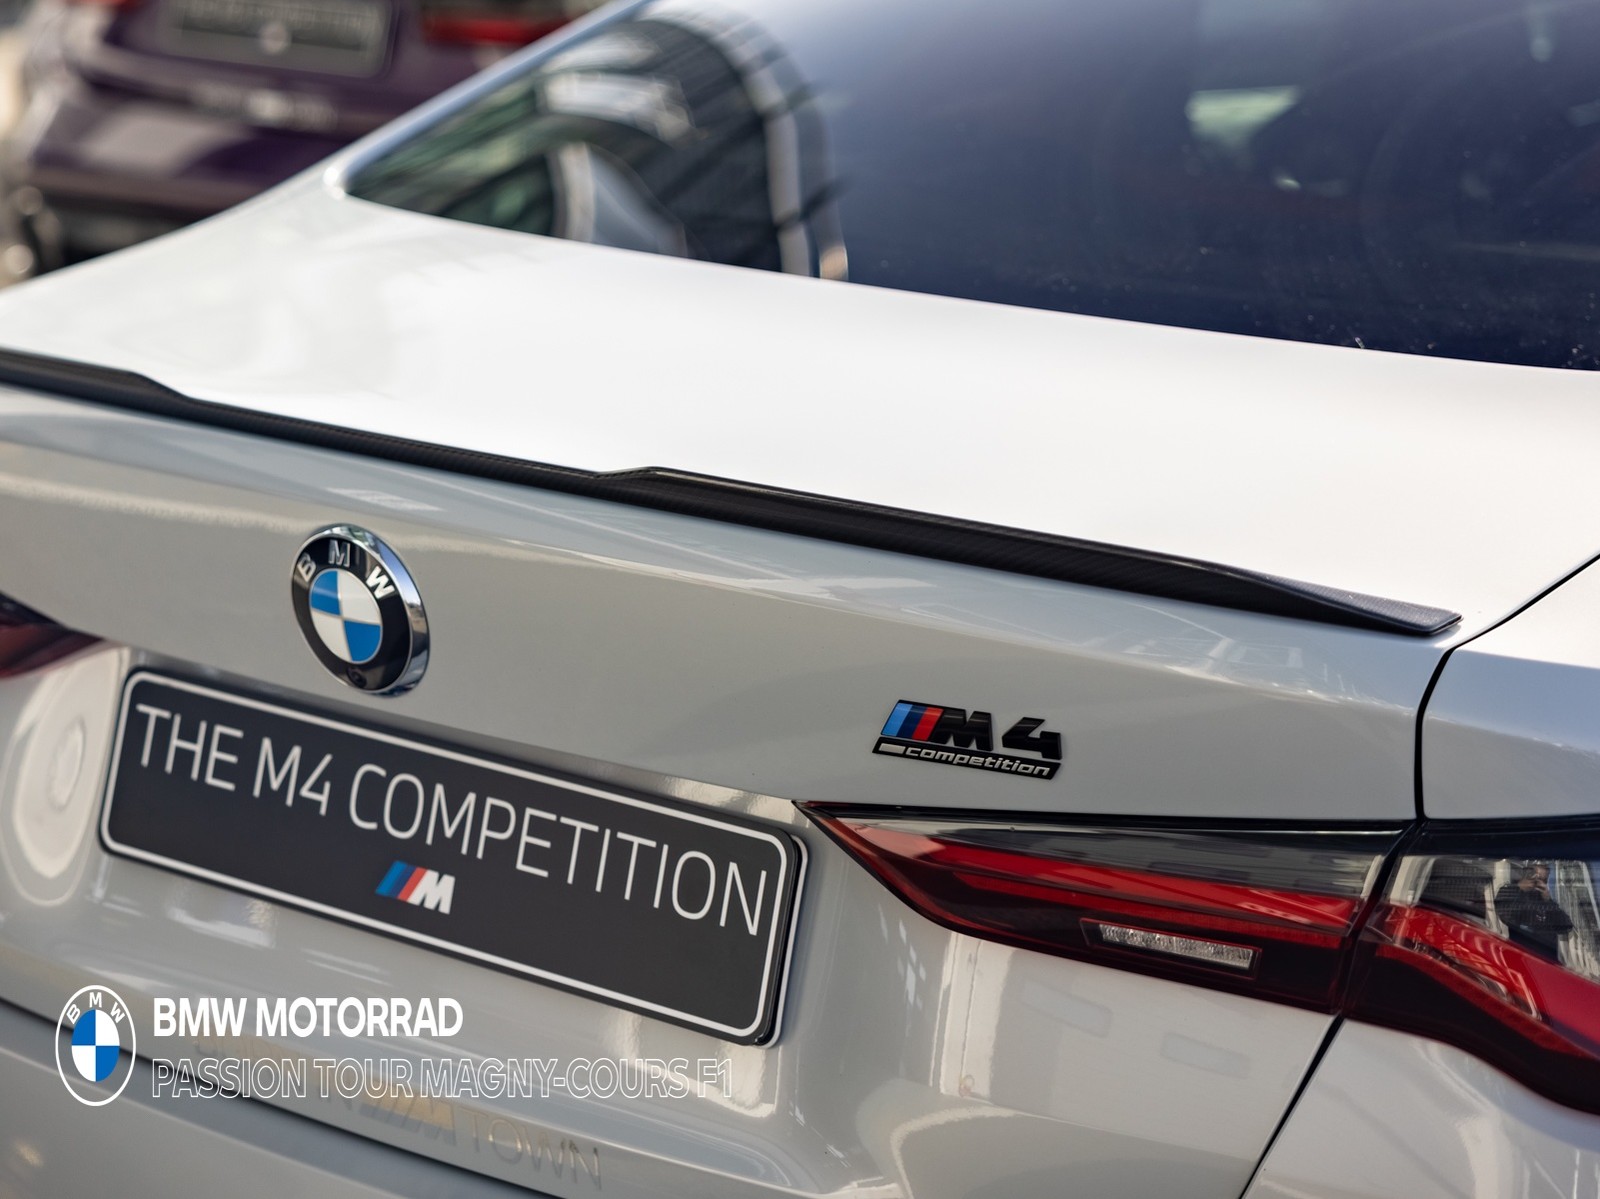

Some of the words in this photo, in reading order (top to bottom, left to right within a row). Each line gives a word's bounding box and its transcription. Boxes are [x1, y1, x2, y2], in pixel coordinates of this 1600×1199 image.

[297, 540, 395, 600] BMW
[905, 746, 1051, 777] competition
[928, 703, 1062, 760] M4
[136, 703, 244, 792] THE
[252, 737, 333, 817] M4
[349, 763, 768, 936] COMPETITION
[459, 1105, 602, 1190] TOWN
